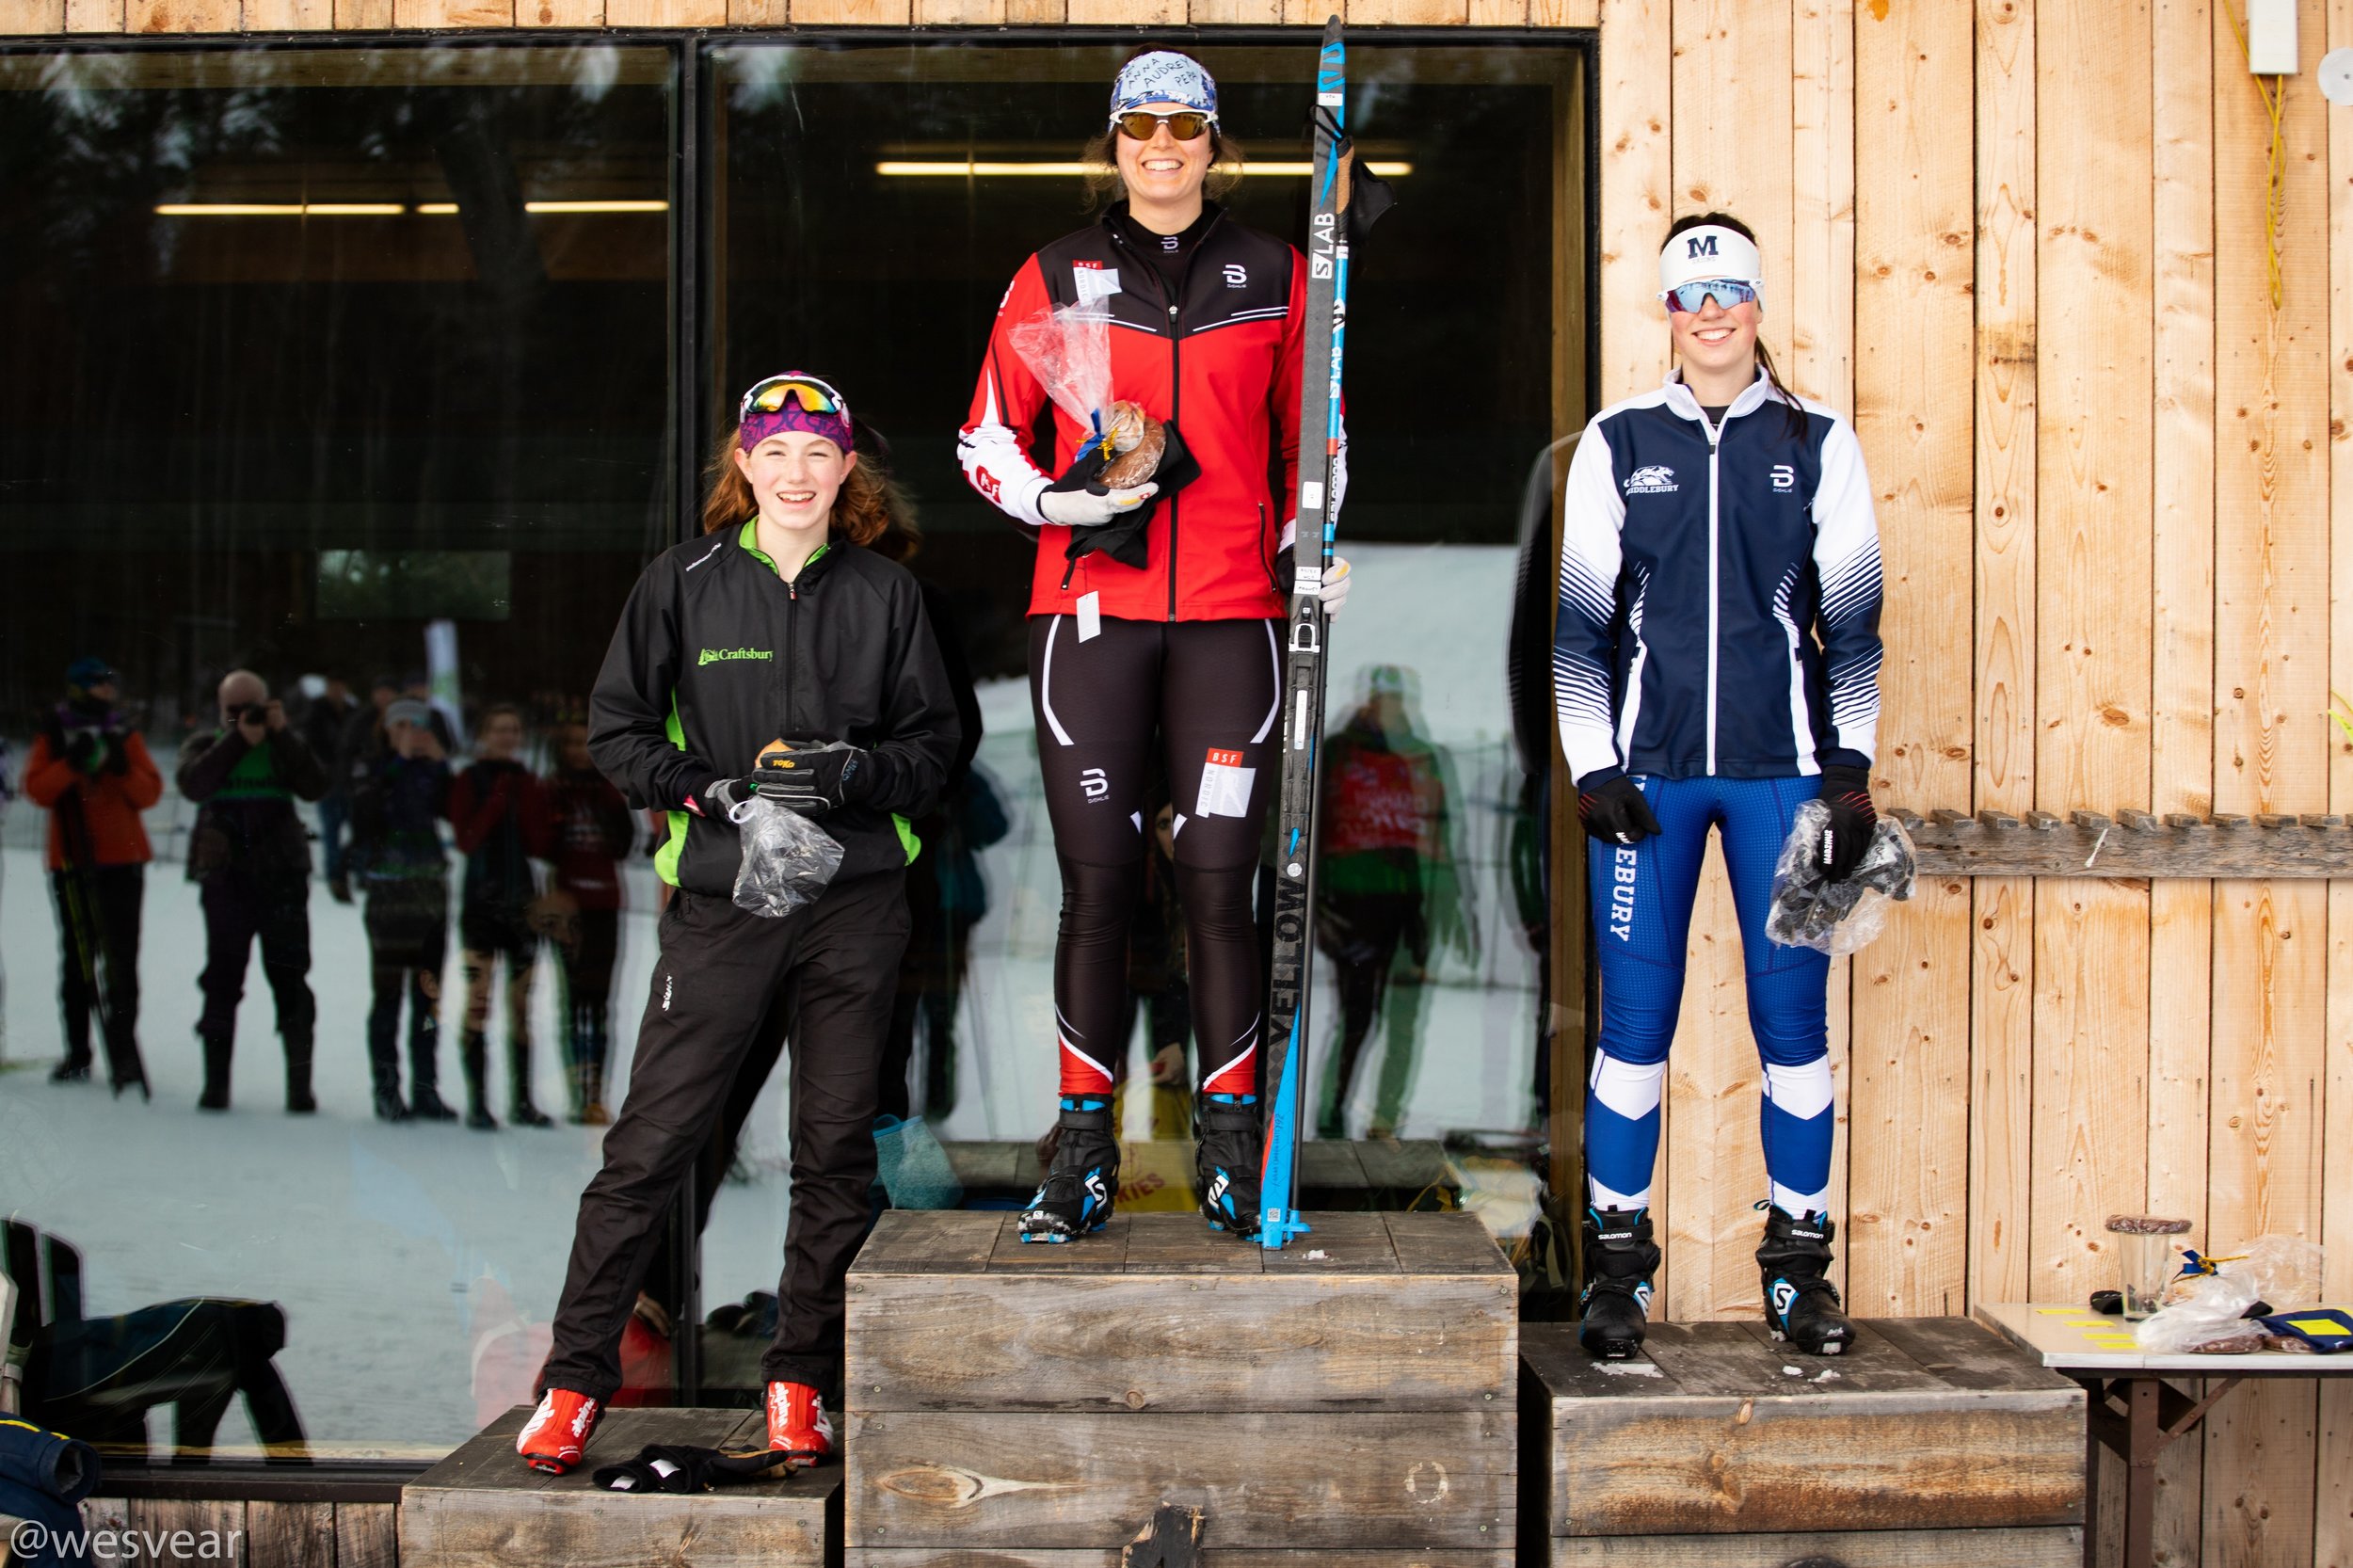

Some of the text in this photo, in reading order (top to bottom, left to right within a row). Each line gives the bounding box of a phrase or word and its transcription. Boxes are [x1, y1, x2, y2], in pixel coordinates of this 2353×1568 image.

[1144, 56, 1191, 88] AUDREY
[1687, 235, 1720, 260] M
[772, 759, 795, 769] TOKO
[1211, 752, 1237, 763] BSF
[1200, 769, 1216, 808] NORDIC
[1609, 847, 1637, 942] EBURY
[1269, 877, 1306, 1046] YELLOW
[1117, 1173, 1165, 1203] KIES
[1791, 1229, 1824, 1239] salomon
